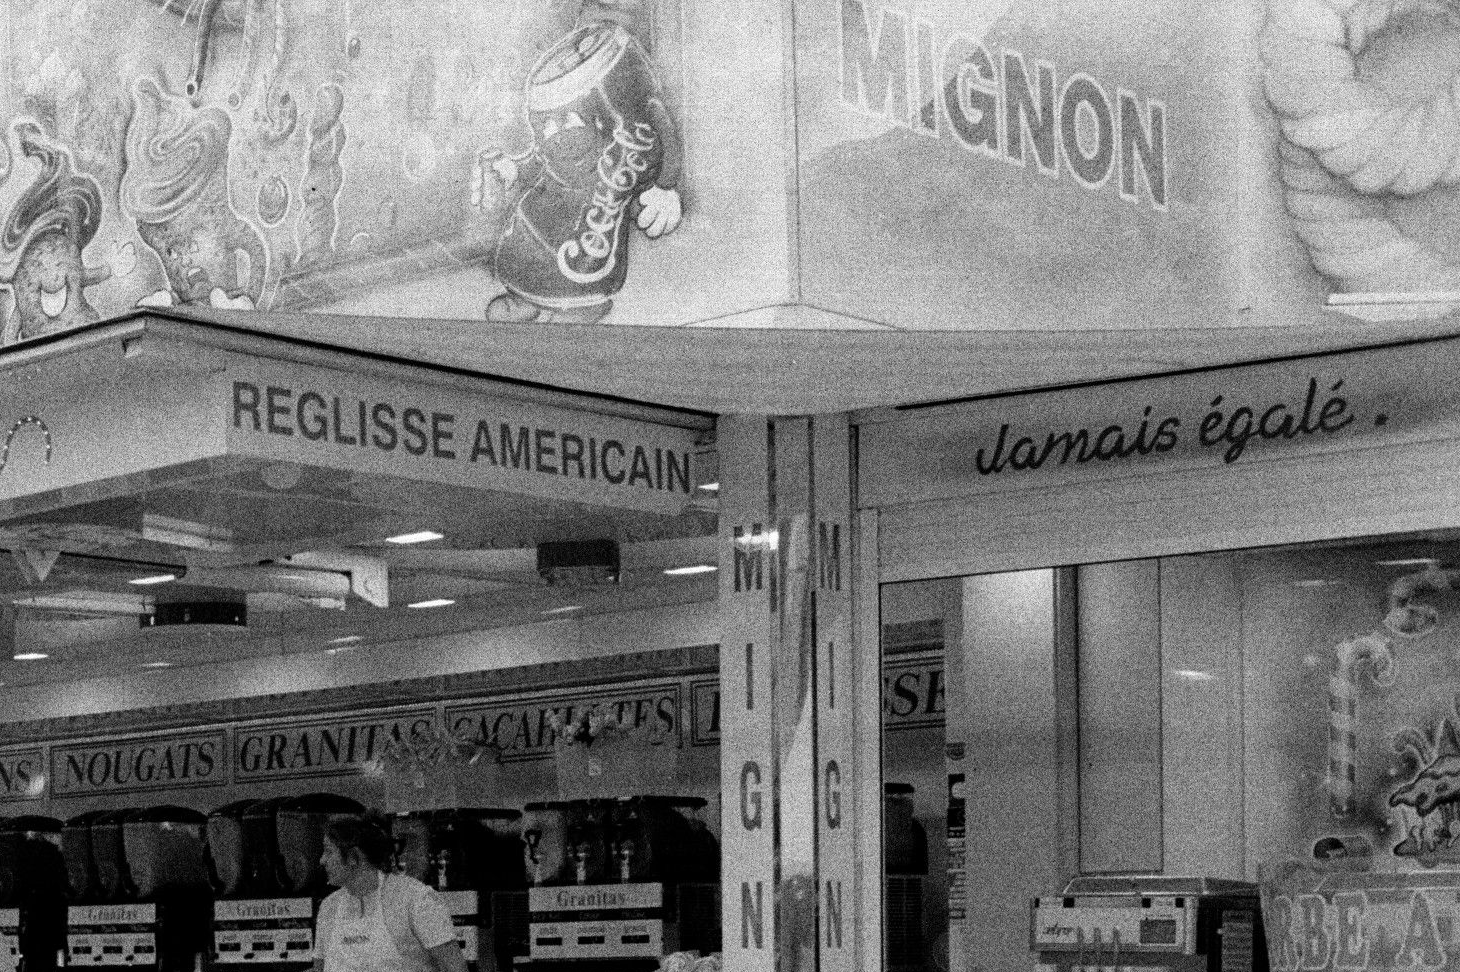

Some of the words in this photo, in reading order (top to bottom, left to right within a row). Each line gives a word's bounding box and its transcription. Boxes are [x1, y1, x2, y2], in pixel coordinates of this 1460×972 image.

[839, 0, 1168, 212] MIGNON
[232, 381, 456, 460] REGLISSE
[470, 420, 691, 493] AMERICAIN
[975, 405, 1180, 476] Jamais
[1198, 378, 1355, 464] égalé
[61, 741, 216, 789] NOUGATS
[240, 718, 433, 774] GRANITAS
[557, 890, 625, 908] Granitas
